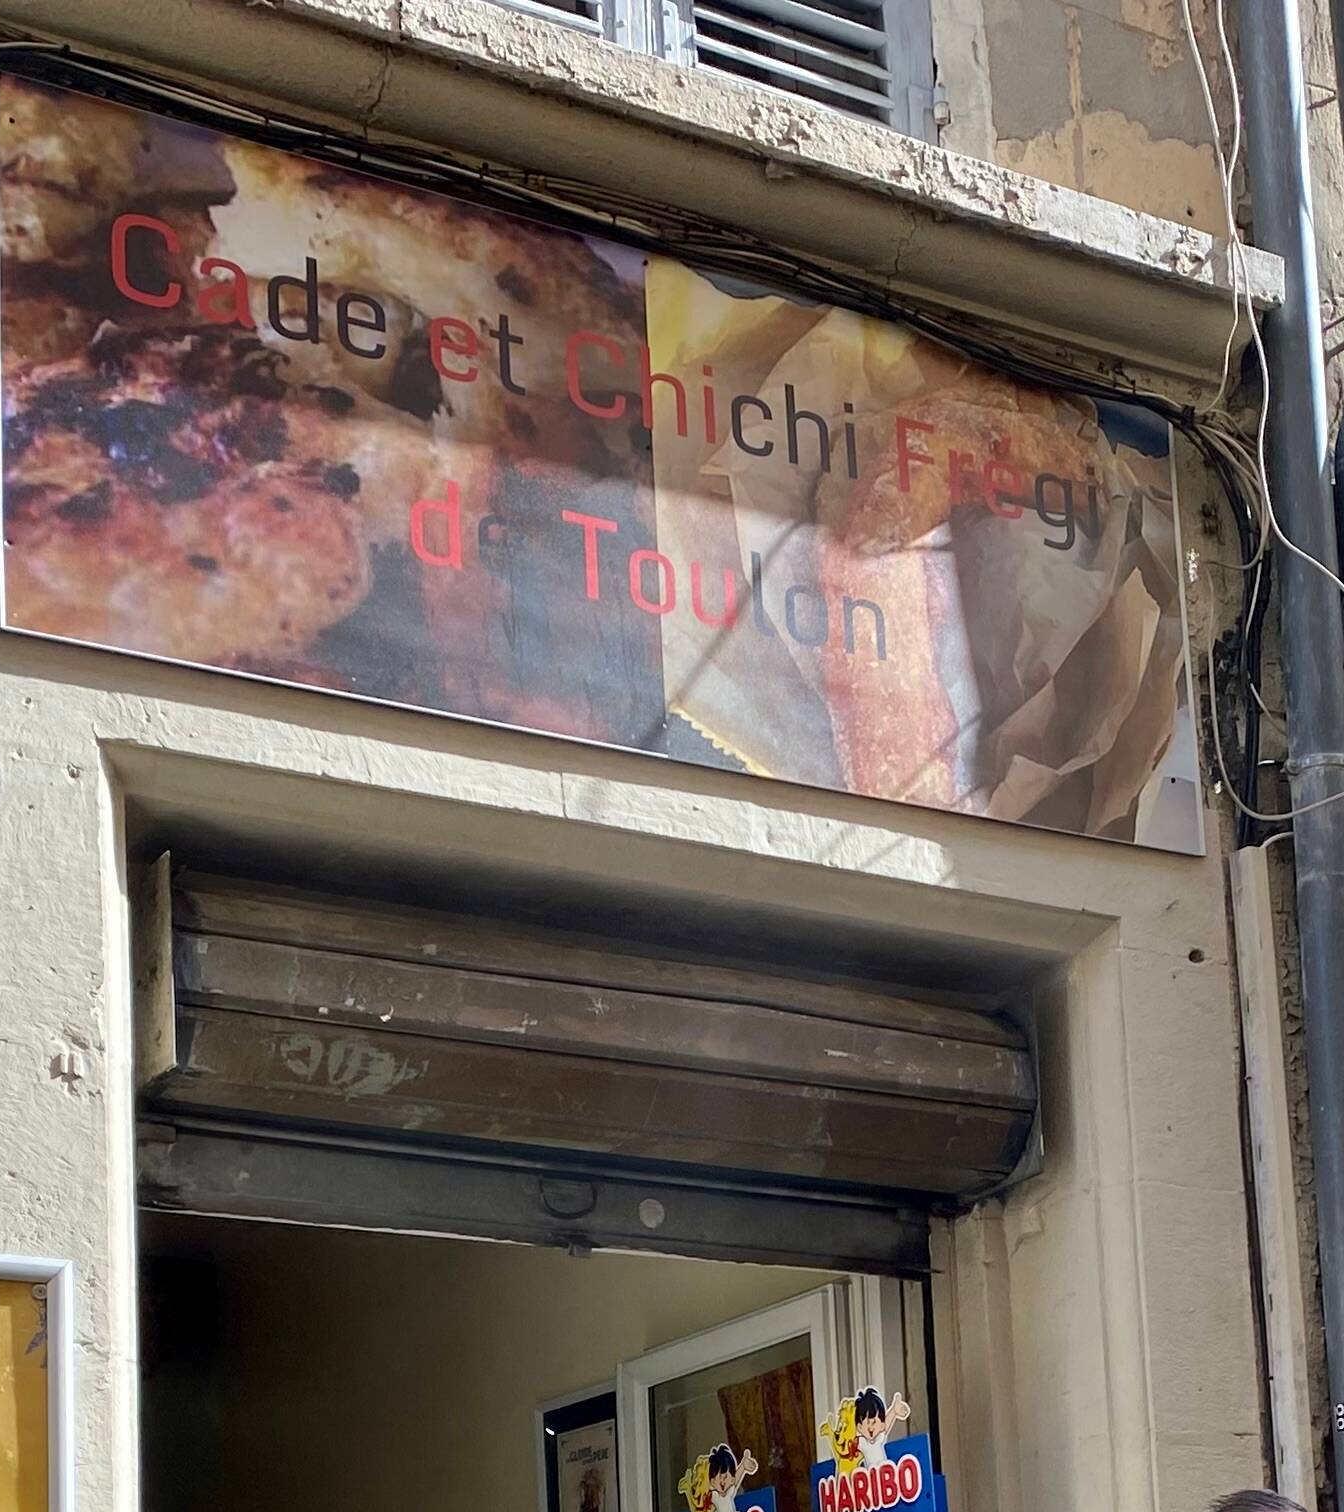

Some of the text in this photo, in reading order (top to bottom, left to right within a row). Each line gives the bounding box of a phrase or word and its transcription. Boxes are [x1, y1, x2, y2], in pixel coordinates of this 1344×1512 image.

[110, 213, 388, 360] Cade
[428, 314, 527, 397] et
[565, 331, 859, 480] Chichi
[562, 509, 887, 661] Toulon
